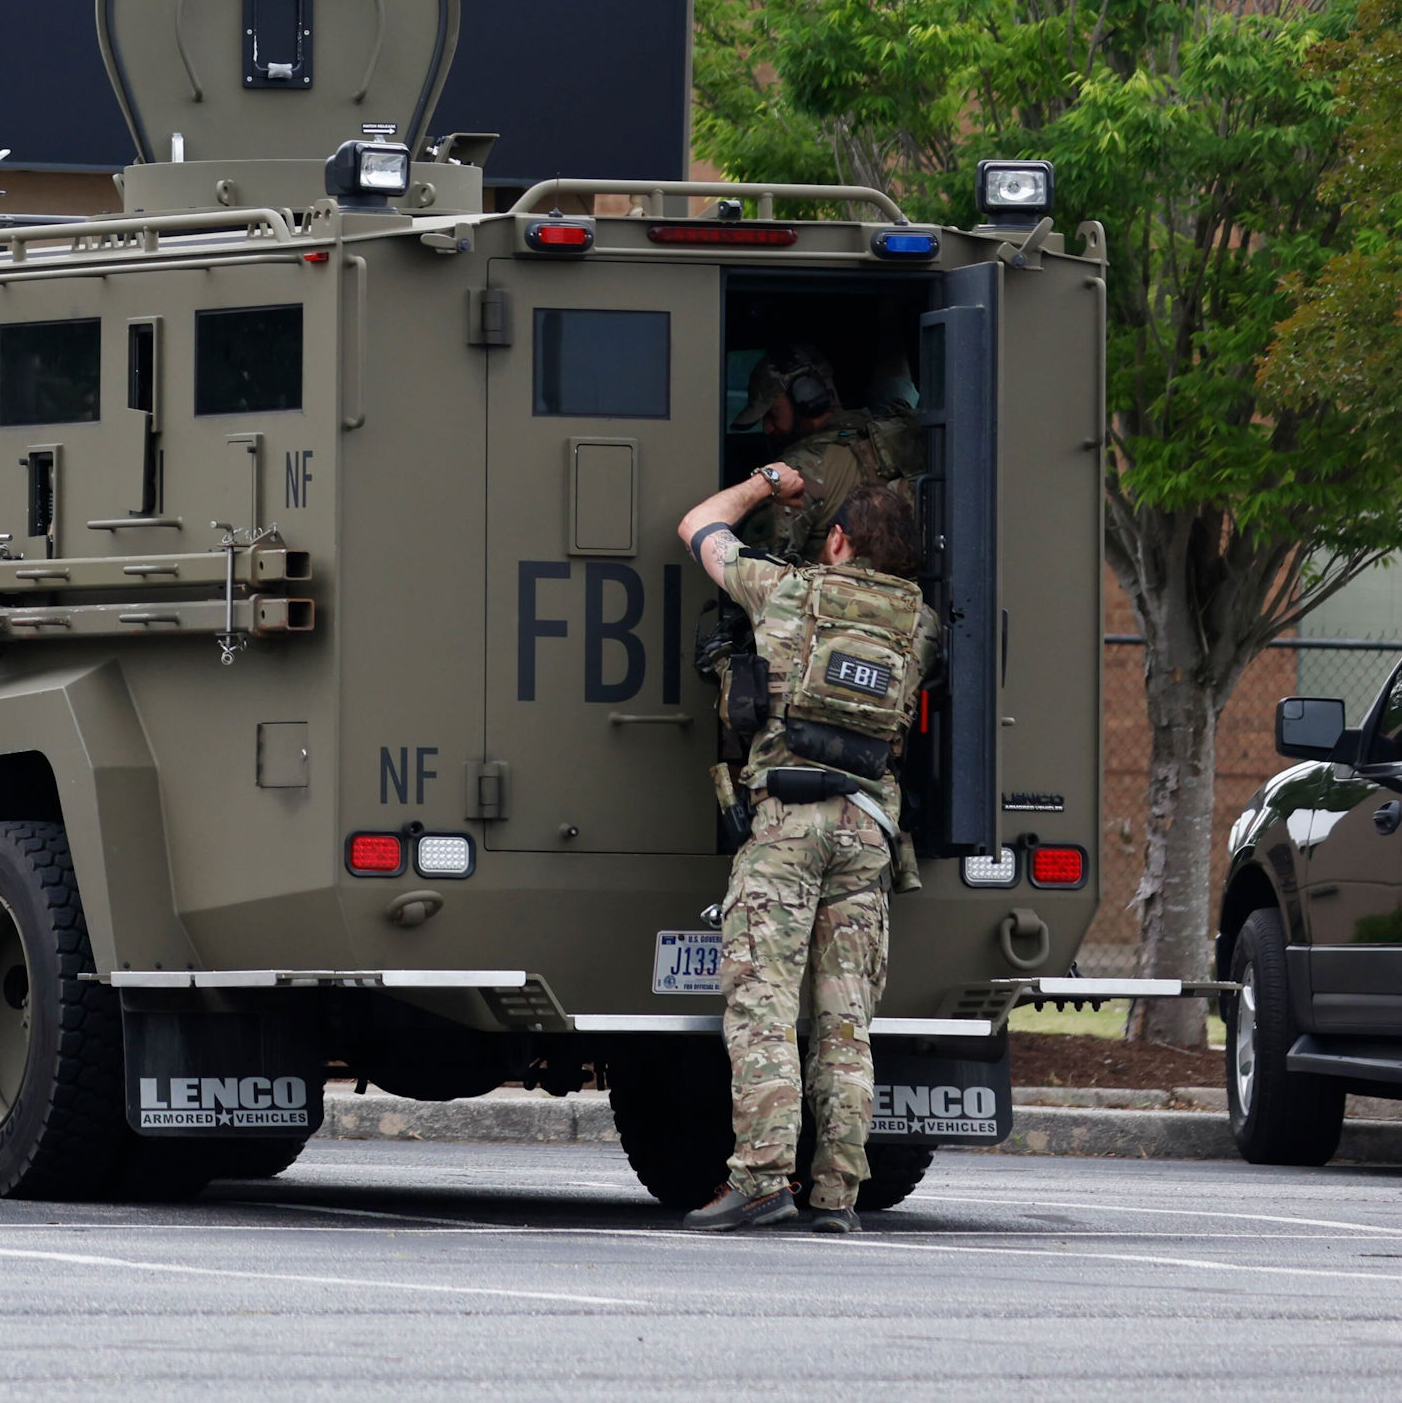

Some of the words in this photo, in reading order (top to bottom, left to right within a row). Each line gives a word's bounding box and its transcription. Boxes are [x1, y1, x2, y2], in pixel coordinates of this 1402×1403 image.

[285, 450, 313, 509] NF
[517, 560, 682, 705] FBI
[838, 660, 879, 689] FBI
[380, 746, 439, 805] NF
[670, 946, 719, 975] J133
[139, 1076, 307, 1110] LENCO
[871, 1084, 997, 1119] ENCO
[143, 1113, 214, 1125] ARMORED
[235, 1112, 307, 1124] VEHICLES
[870, 1120, 906, 1131] ORED
[927, 1121, 996, 1134] VEHICLES
